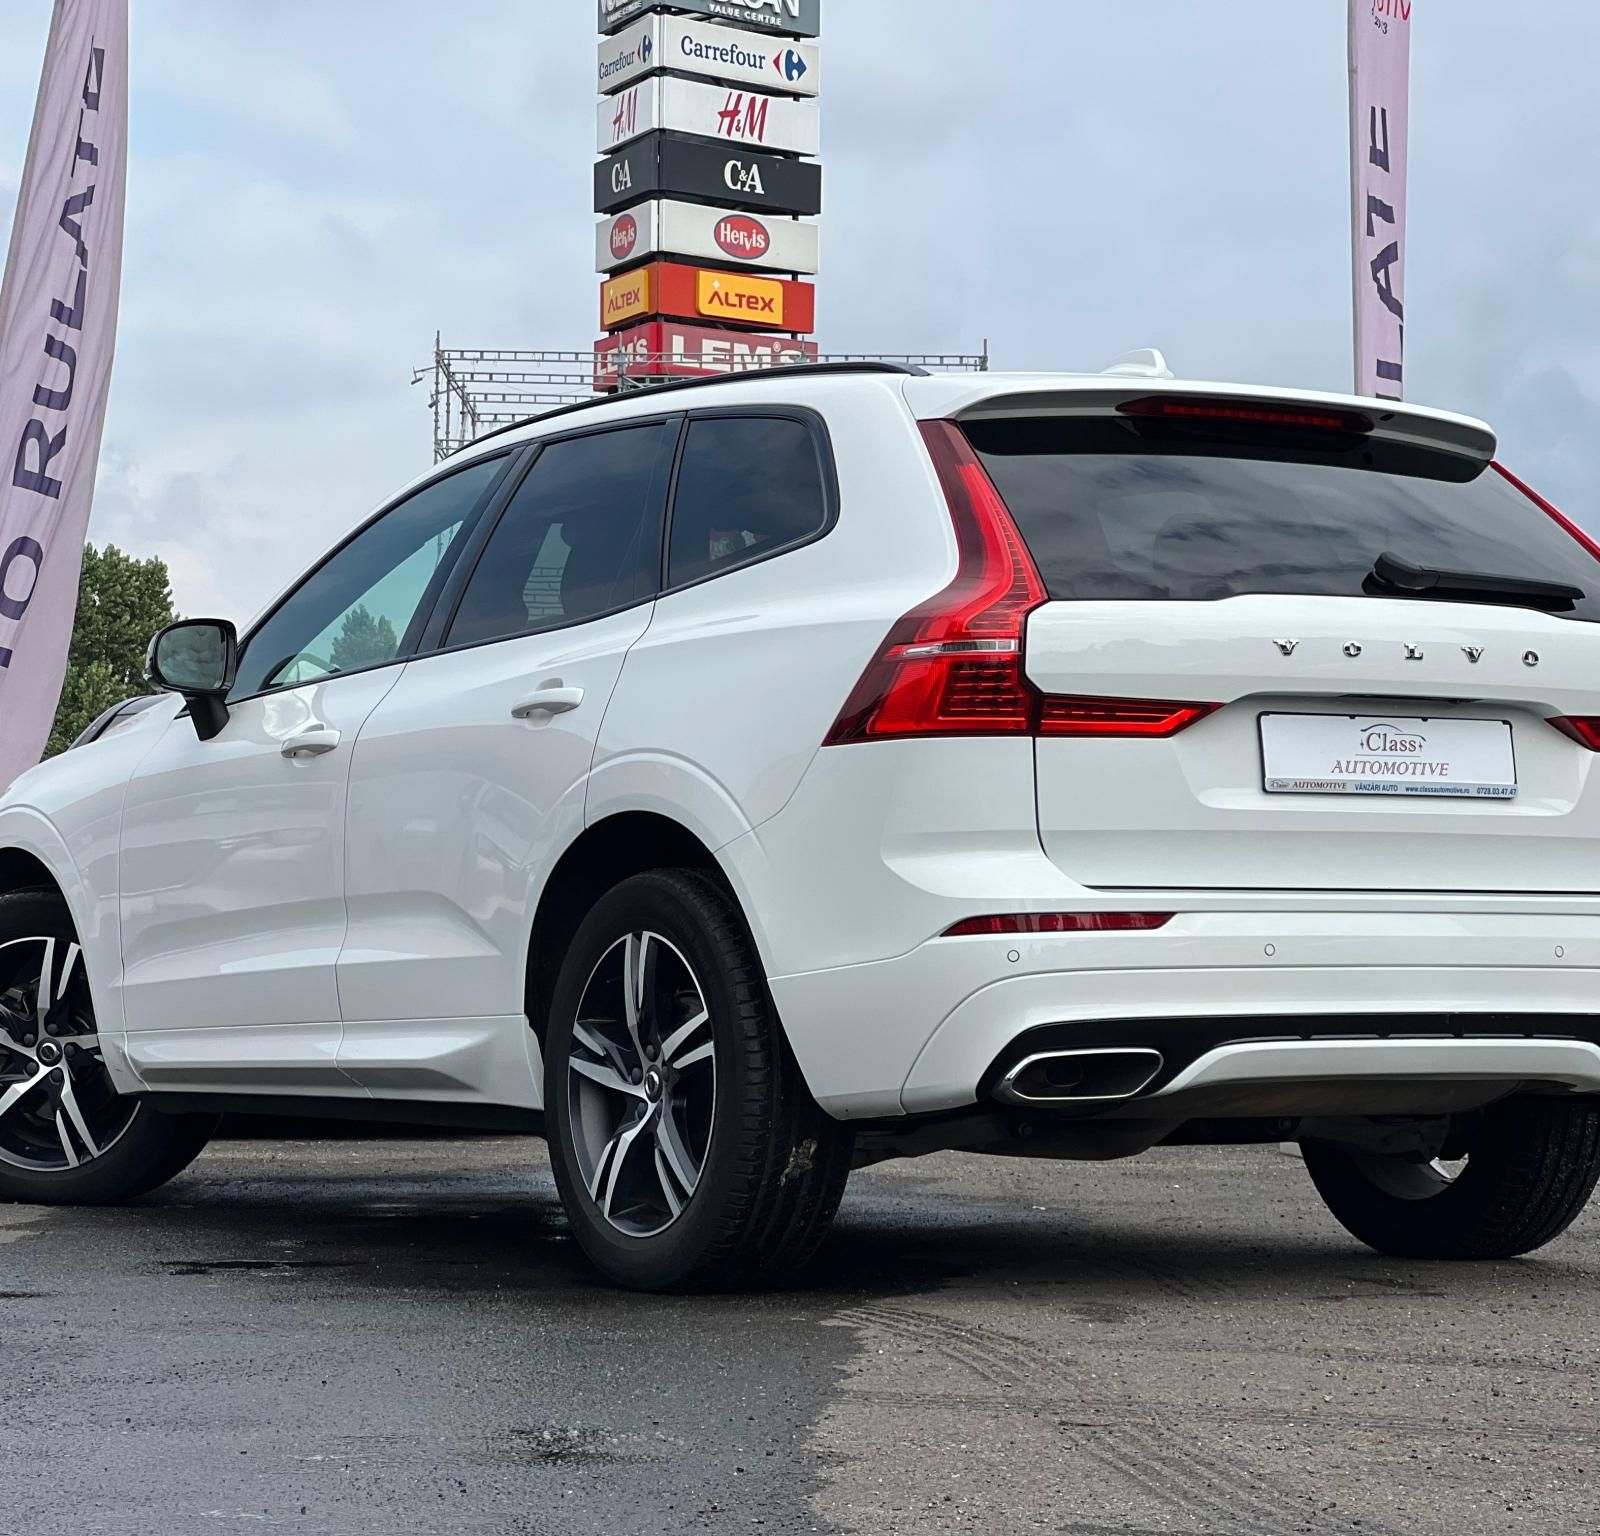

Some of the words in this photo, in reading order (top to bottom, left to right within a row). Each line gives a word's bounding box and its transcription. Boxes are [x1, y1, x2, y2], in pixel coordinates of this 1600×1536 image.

[709, 3, 740, 17] VALUE
[743, 11, 782, 26] CENTRE
[599, 50, 636, 80] Carrefour
[680, 35, 766, 70] Carrefour
[612, 87, 638, 142] H&M
[717, 91, 769, 143] H&M
[611, 159, 632, 193] C&A
[723, 159, 765, 194] C&A
[612, 226, 635, 248] Hervis
[720, 222, 766, 251] Hervis
[1272, 637, 1540, 667] VOLVO
[1366, 732, 1417, 752] Class
[1331, 760, 1449, 777] AUTOMOTIVE
[1292, 781, 1347, 790] AUTOMOTIVE
[1381, 784, 1398, 792] AUTO
